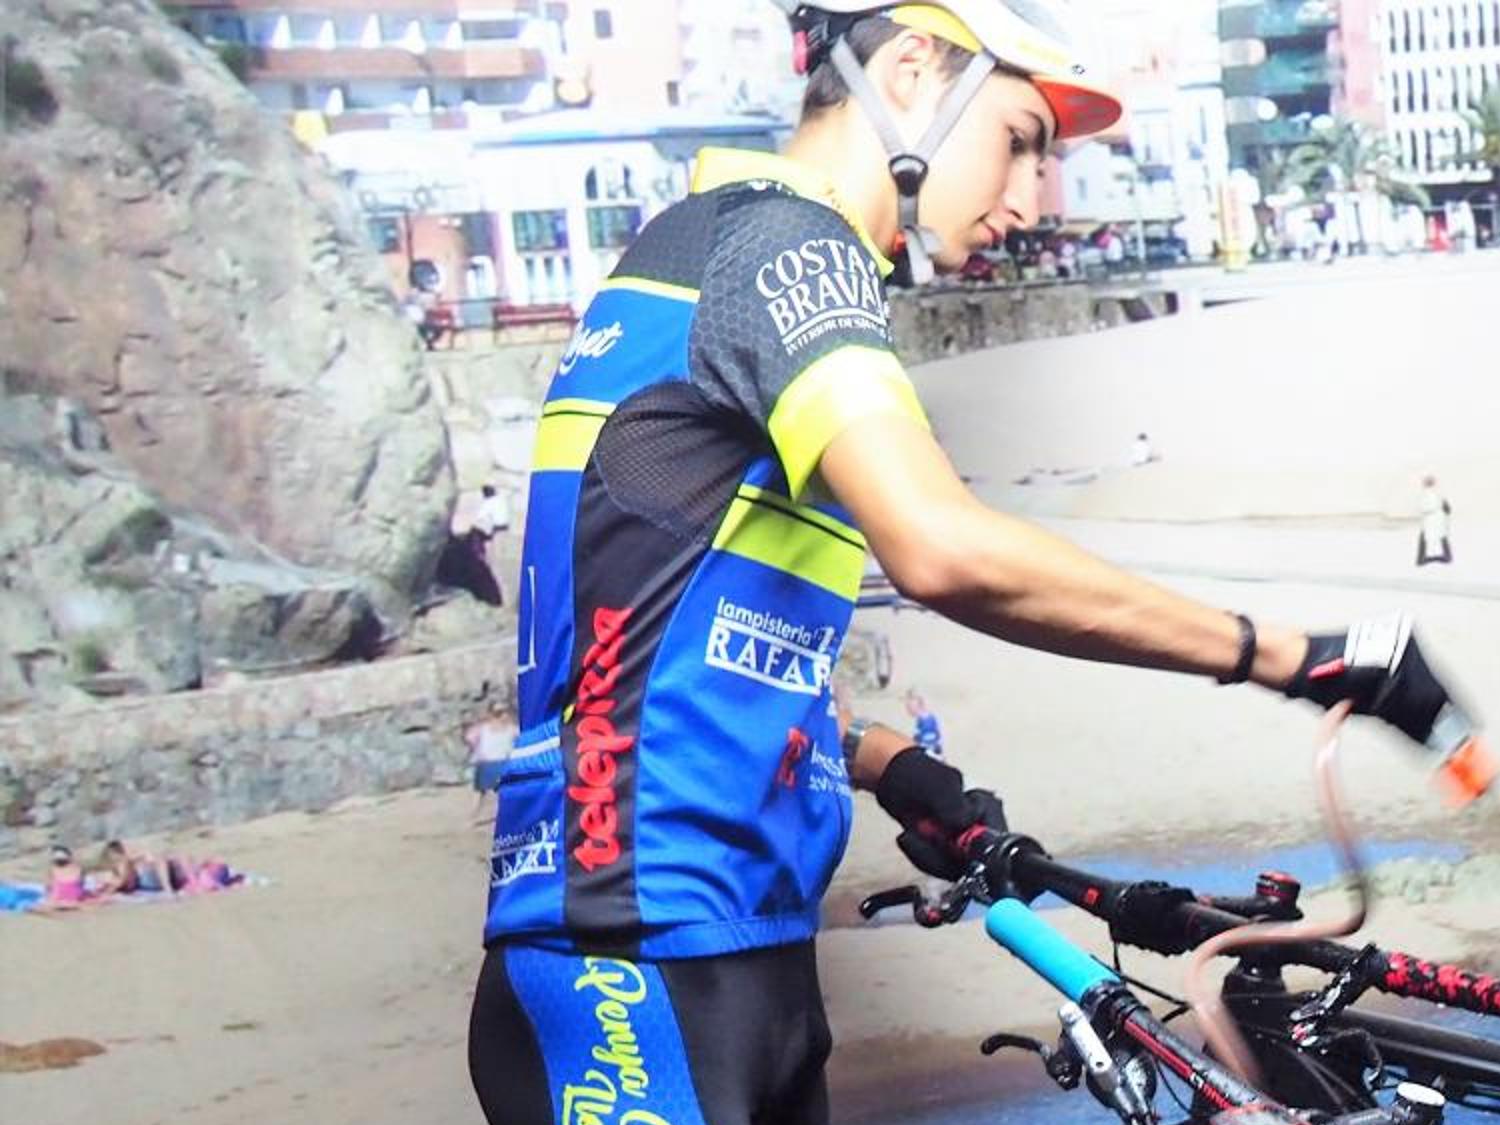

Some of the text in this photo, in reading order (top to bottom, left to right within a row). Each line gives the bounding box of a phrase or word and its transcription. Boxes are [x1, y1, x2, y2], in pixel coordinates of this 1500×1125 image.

[756, 239, 877, 299] COSTA
[767, 268, 891, 336] BRAVA
[716, 595, 813, 646] lampisteria
